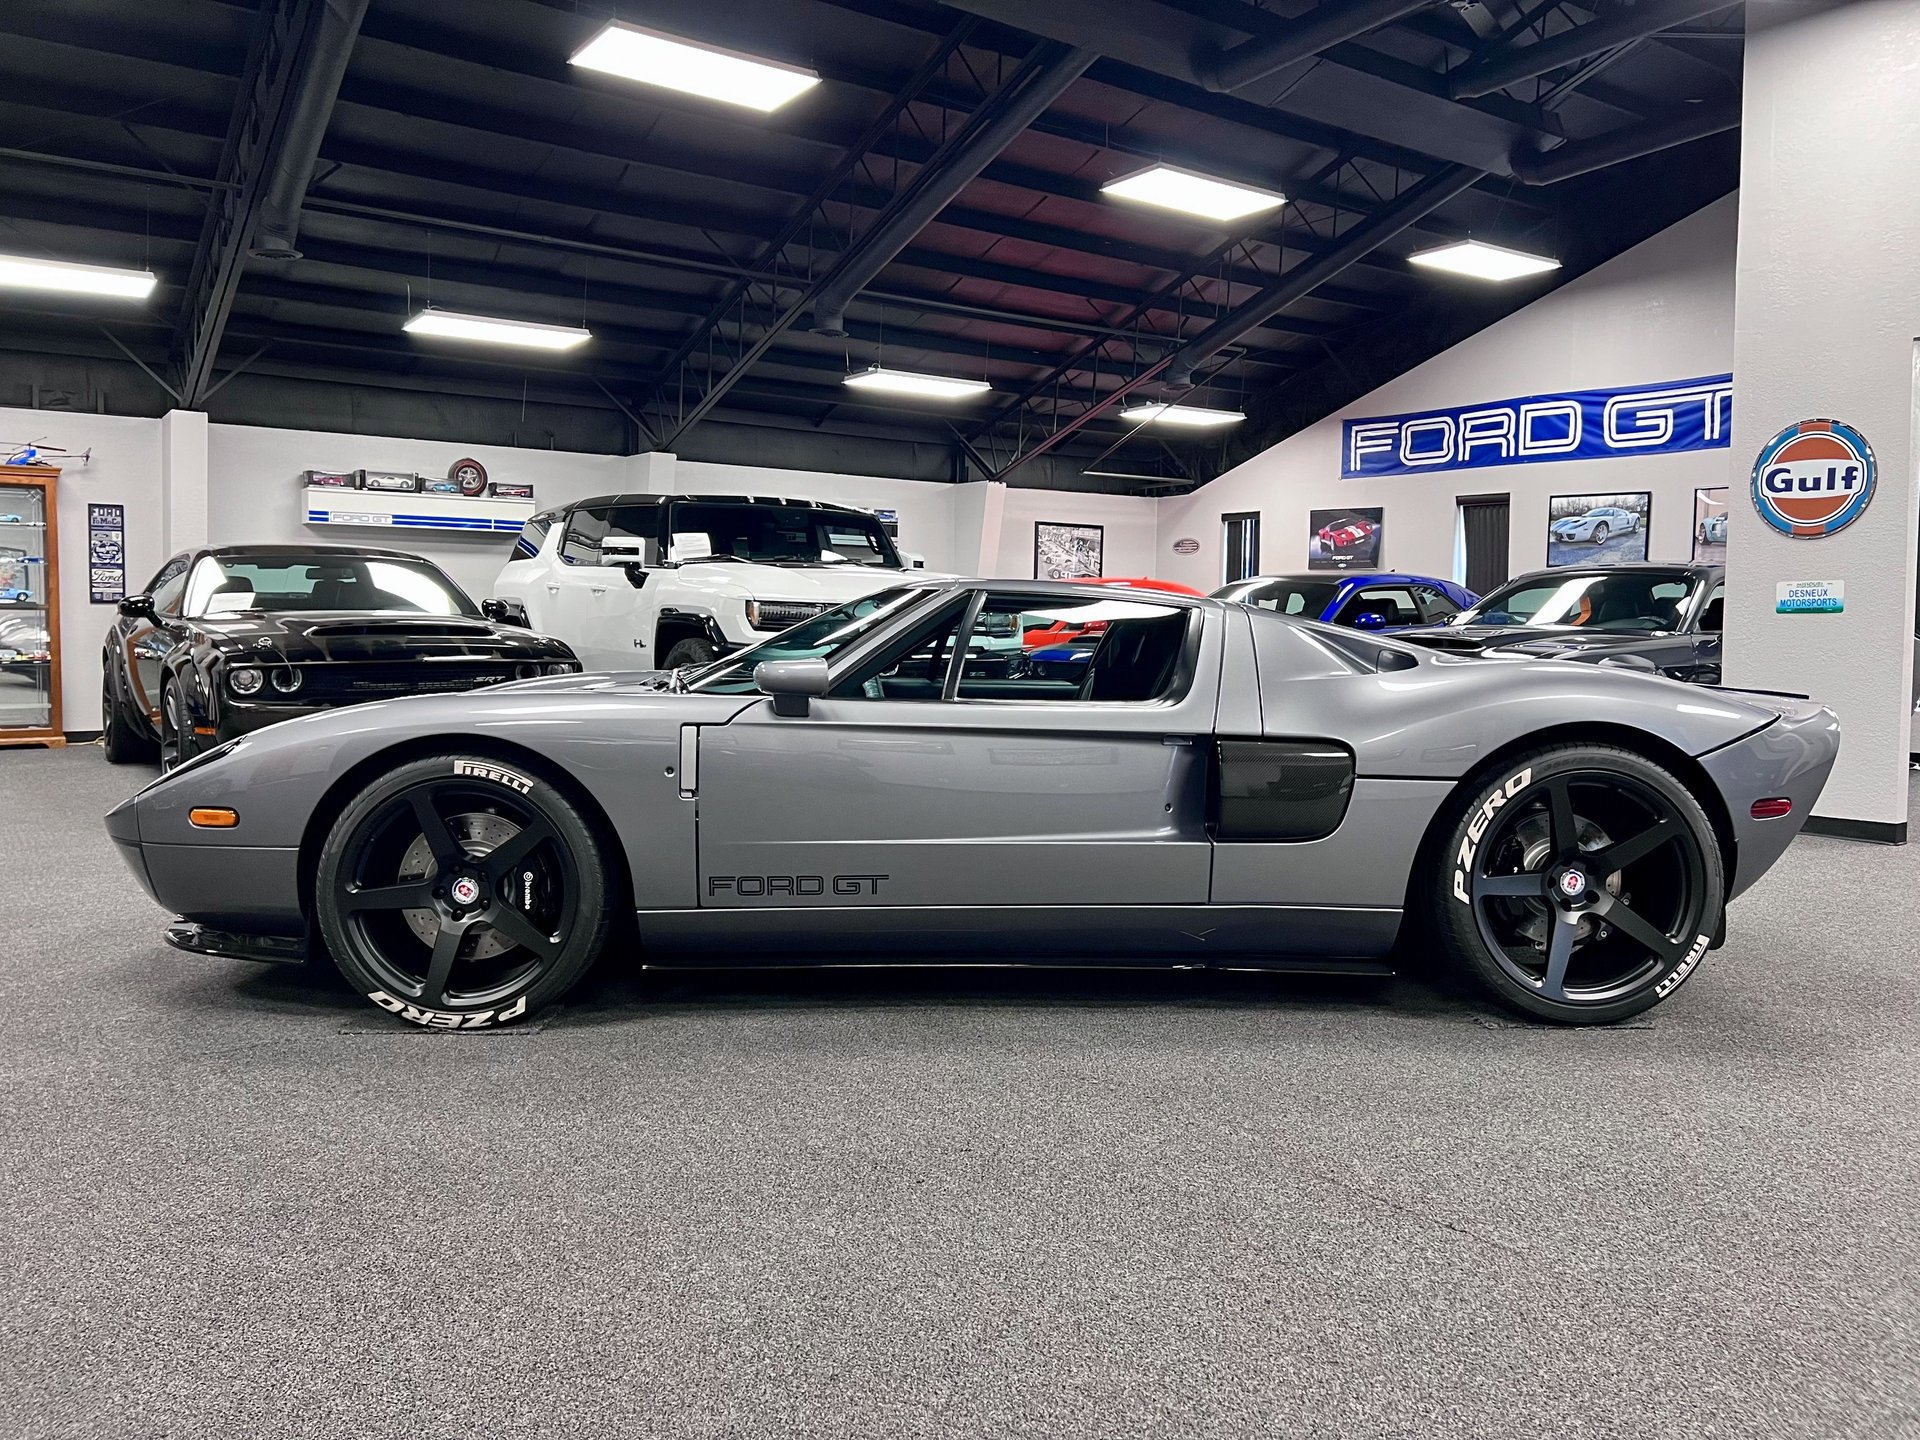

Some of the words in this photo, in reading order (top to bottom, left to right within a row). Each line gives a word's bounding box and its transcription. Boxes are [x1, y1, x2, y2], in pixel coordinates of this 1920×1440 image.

[1349, 400, 1583, 472] FORD
[1603, 382, 1733, 448] GT
[1765, 466, 1858, 493] Gulf
[332, 514, 370, 522] FORD
[92, 570, 123, 582] Ford
[1780, 597, 1837, 607] MOTORSPORTS
[1788, 589, 1829, 598] DESNEUX
[473, 675, 506, 684] SRT
[453, 760, 534, 795] PIRELLI
[1453, 767, 1533, 905] PZERO
[524, 881, 533, 910] brembo
[708, 875, 824, 897] FORD
[832, 874, 890, 896] GT
[1655, 934, 1710, 998] PIRELLI
[367, 990, 526, 1029] PZERO
